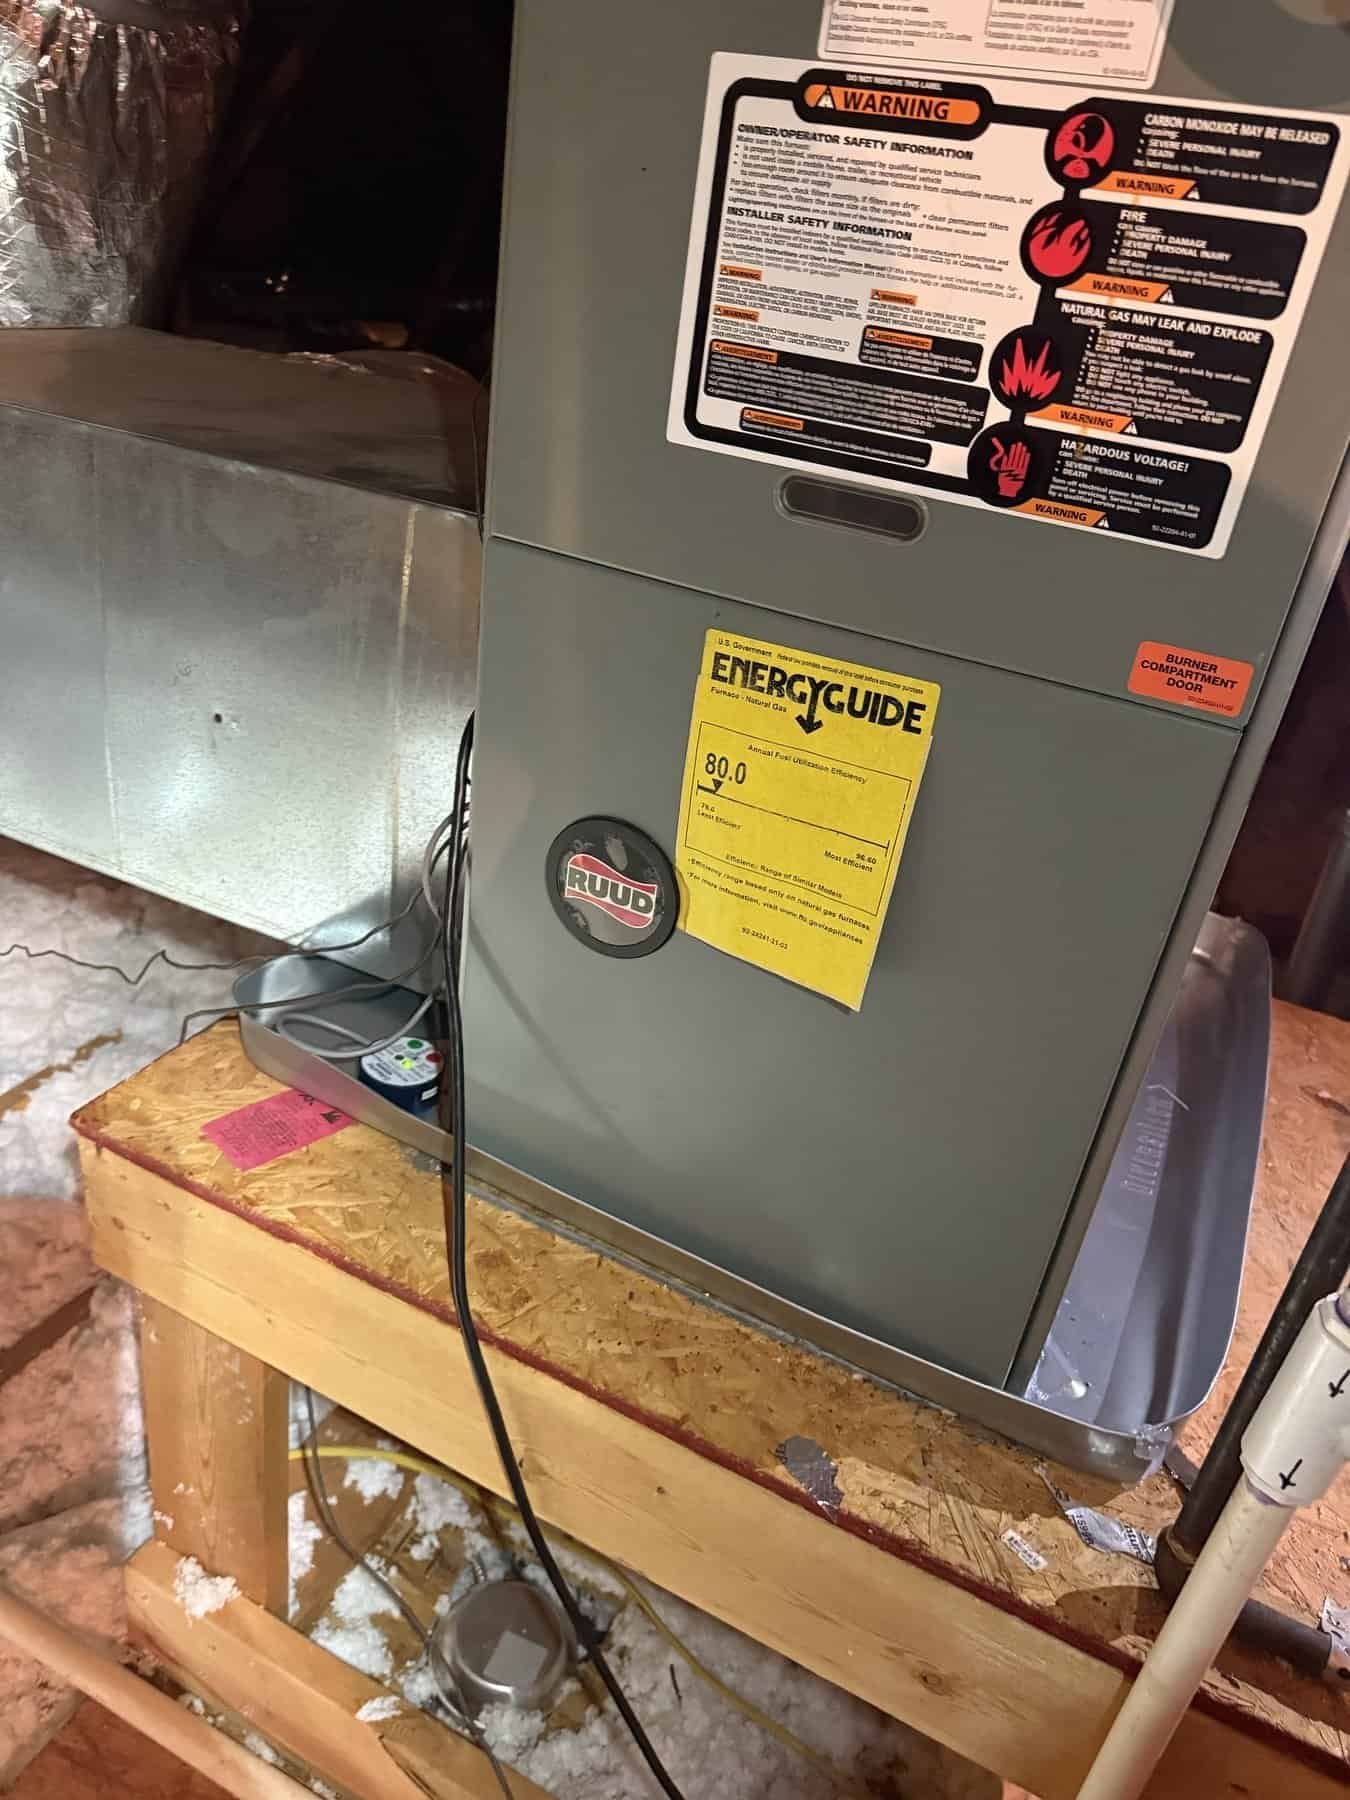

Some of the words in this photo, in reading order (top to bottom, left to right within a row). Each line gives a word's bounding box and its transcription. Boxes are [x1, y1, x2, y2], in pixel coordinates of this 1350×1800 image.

[842, 90, 949, 119] WARNING
[737, 123, 841, 144] OWNER/OPERATOR
[842, 136, 888, 149] SAFETY
[889, 141, 973, 160] INFORMATION
[1142, 113, 1185, 130] CARBON
[1184, 118, 1239, 135] MONOXIDE
[1238, 123, 1264, 138] MAY
[1262, 126, 1278, 139] BE
[1277, 127, 1331, 145] RELEASED
[1114, 178, 1176, 194] WARNING
[726, 205, 785, 222] INSTALLER
[786, 214, 830, 229] SAFETY
[831, 220, 912, 240] INFORMATION
[1119, 209, 1148, 223] FIRE
[1091, 279, 1150, 297] WARNING
[1060, 302, 1107, 320] NATURAL
[1106, 309, 1131, 323] GAS
[1130, 313, 1157, 327] MAY
[1156, 317, 1186, 332] LEAK
[1185, 321, 1212, 336] AND
[1211, 325, 1262, 344] EXPLODE
[1059, 410, 1114, 427] WARNING
[1059, 439, 1131, 462] HAZARDOUS
[1131, 452, 1189, 472] VOLTAGE!
[1034, 503, 1087, 522] WARNING
[1140, 659, 1238, 689] COMPARTMENT
[1166, 653, 1218, 673] BURNER
[710, 651, 927, 736] ENERGYGUIDE
[1166, 677, 1203, 693] DOOR
[704, 751, 747, 785] 80.0
[567, 867, 655, 914] RUUD
